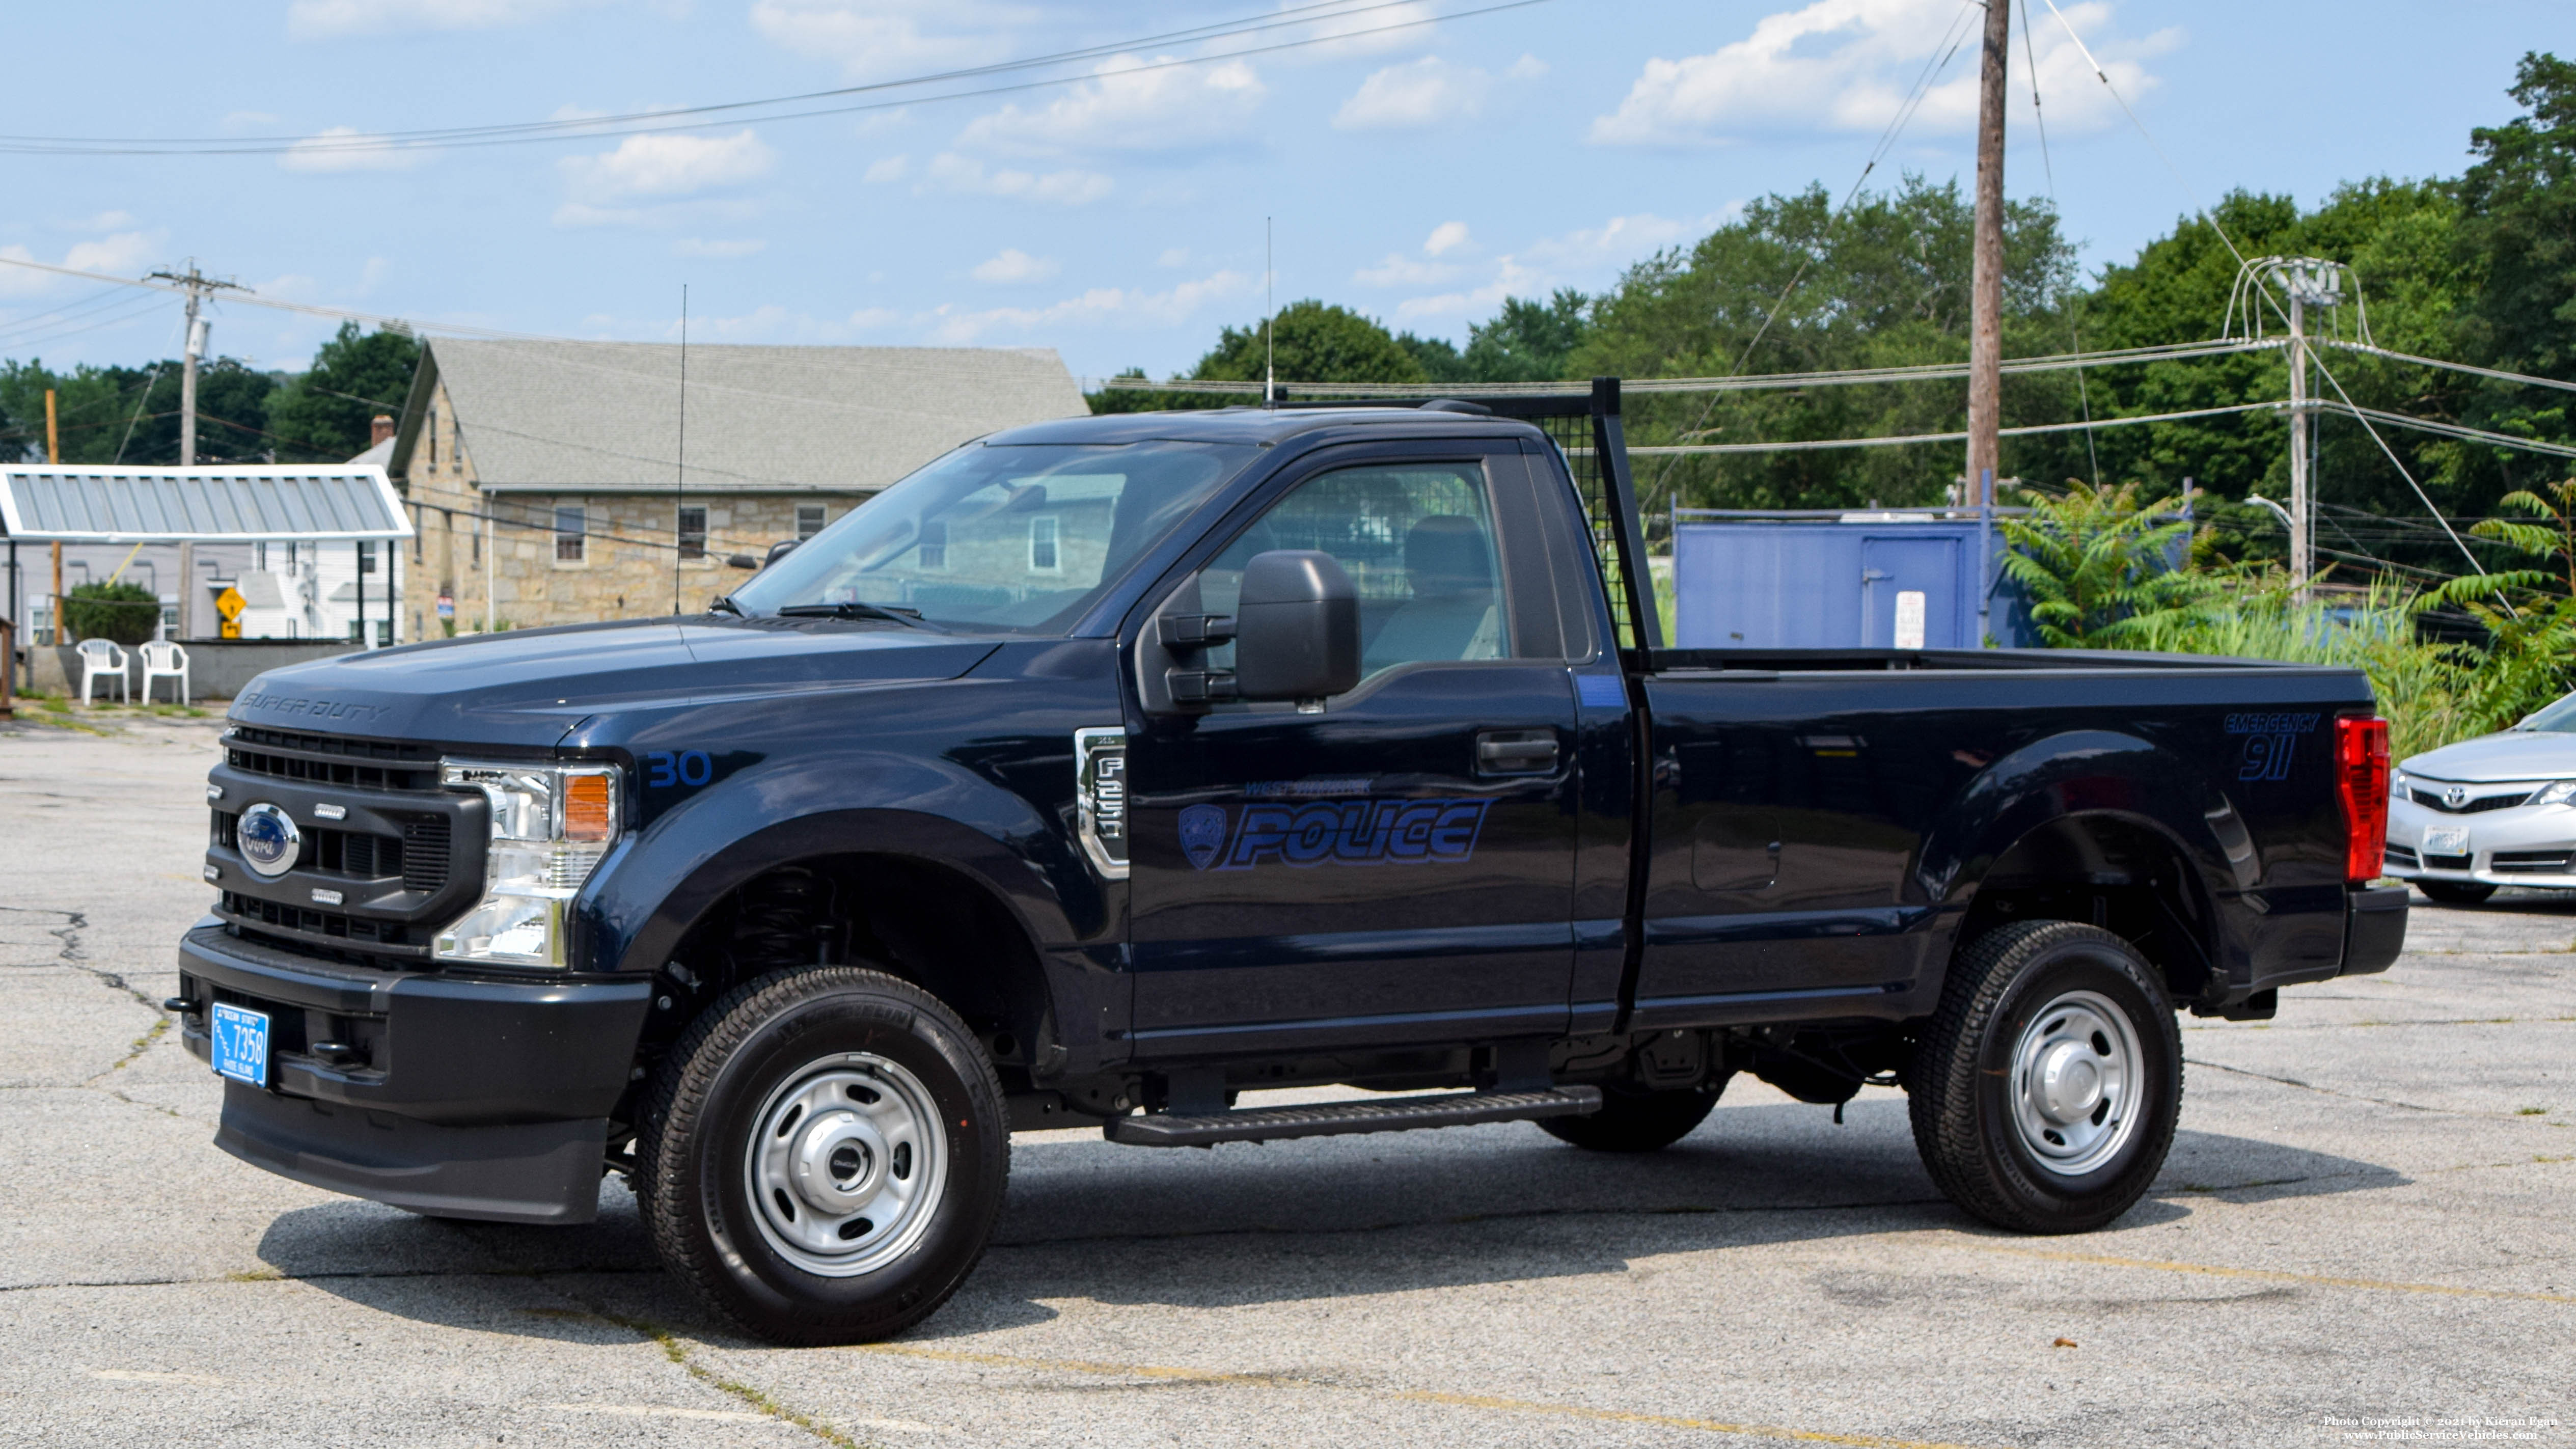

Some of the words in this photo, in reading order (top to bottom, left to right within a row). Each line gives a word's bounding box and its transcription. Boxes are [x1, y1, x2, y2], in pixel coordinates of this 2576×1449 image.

[240, 693, 309, 713] SUPER
[309, 701, 391, 721] DUTY
[2224, 713, 2321, 733] EMERGENCY
[648, 750, 712, 788] 30
[2238, 733, 2297, 782] 911
[1245, 780, 1293, 796] WEST
[1215, 797, 1498, 870] POLICE
[233, 1024, 264, 1065] 7358
